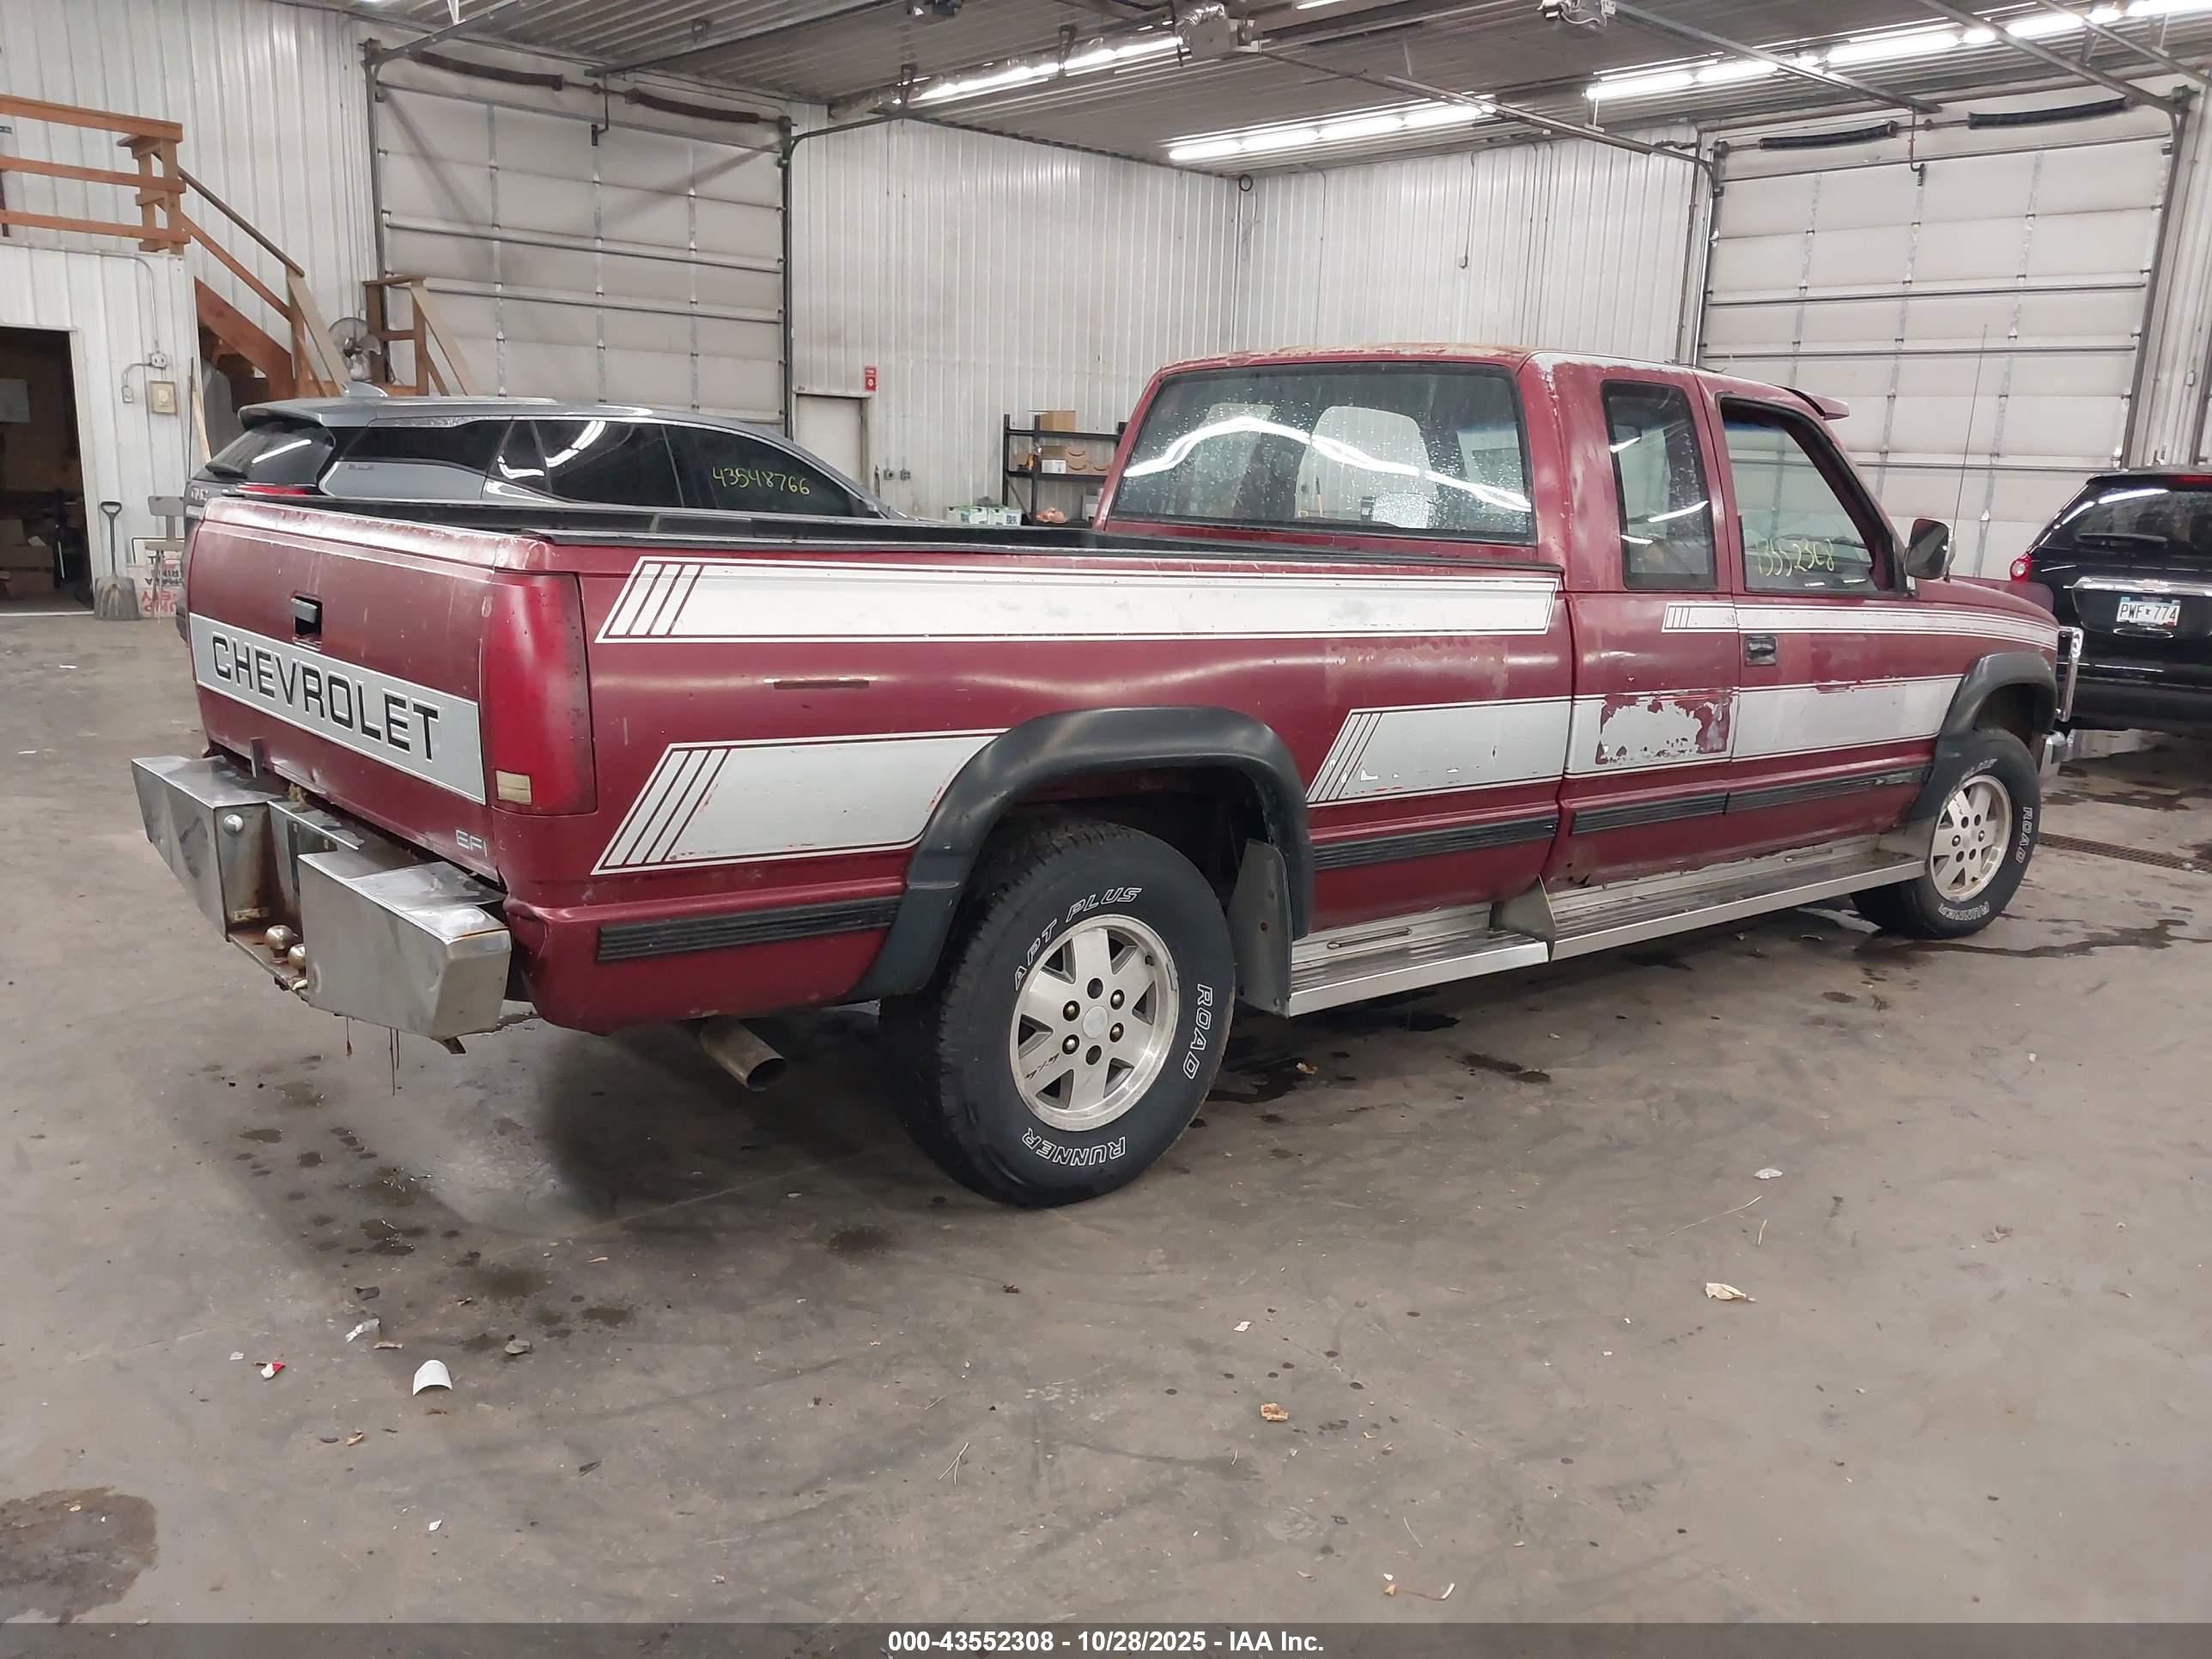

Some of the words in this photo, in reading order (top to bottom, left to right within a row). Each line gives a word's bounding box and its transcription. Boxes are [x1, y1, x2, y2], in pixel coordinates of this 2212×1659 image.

[712, 466, 811, 495] 43548766
[212, 631, 440, 763] CHEVROLET
[455, 829, 488, 858] EFI
[2015, 806, 2033, 864] ROAD
[1015, 918, 1057, 990] APT
[1066, 887, 1142, 923] PLUS
[1182, 983, 1213, 1080] ROAD
[1021, 1127, 1127, 1167] RUNNER
